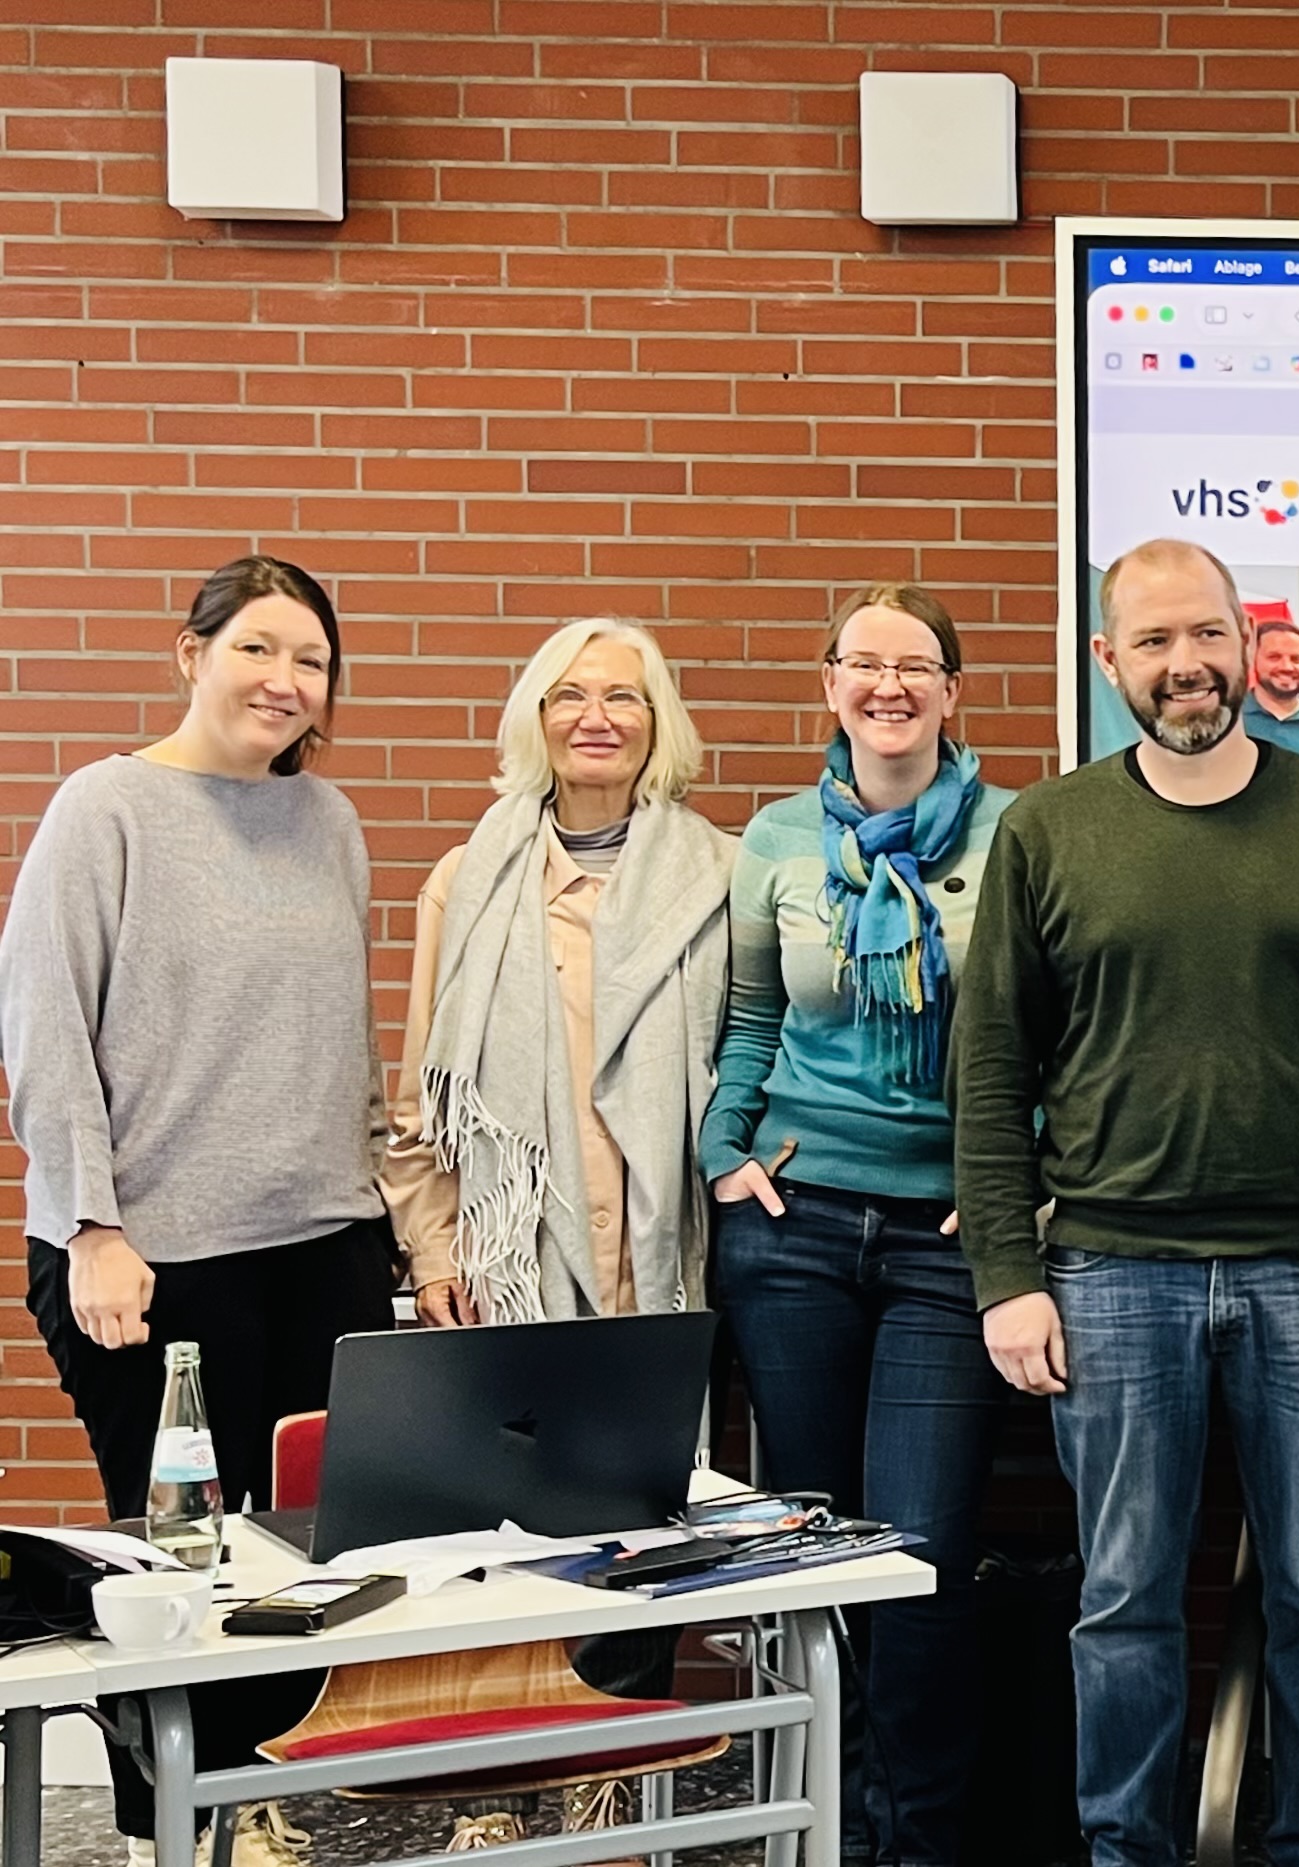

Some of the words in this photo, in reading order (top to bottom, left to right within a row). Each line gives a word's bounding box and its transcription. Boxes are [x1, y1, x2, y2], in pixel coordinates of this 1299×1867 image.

[1147, 258, 1193, 275] Safari
[1213, 259, 1263, 277] Ablage
[1172, 478, 1250, 517] vhs
